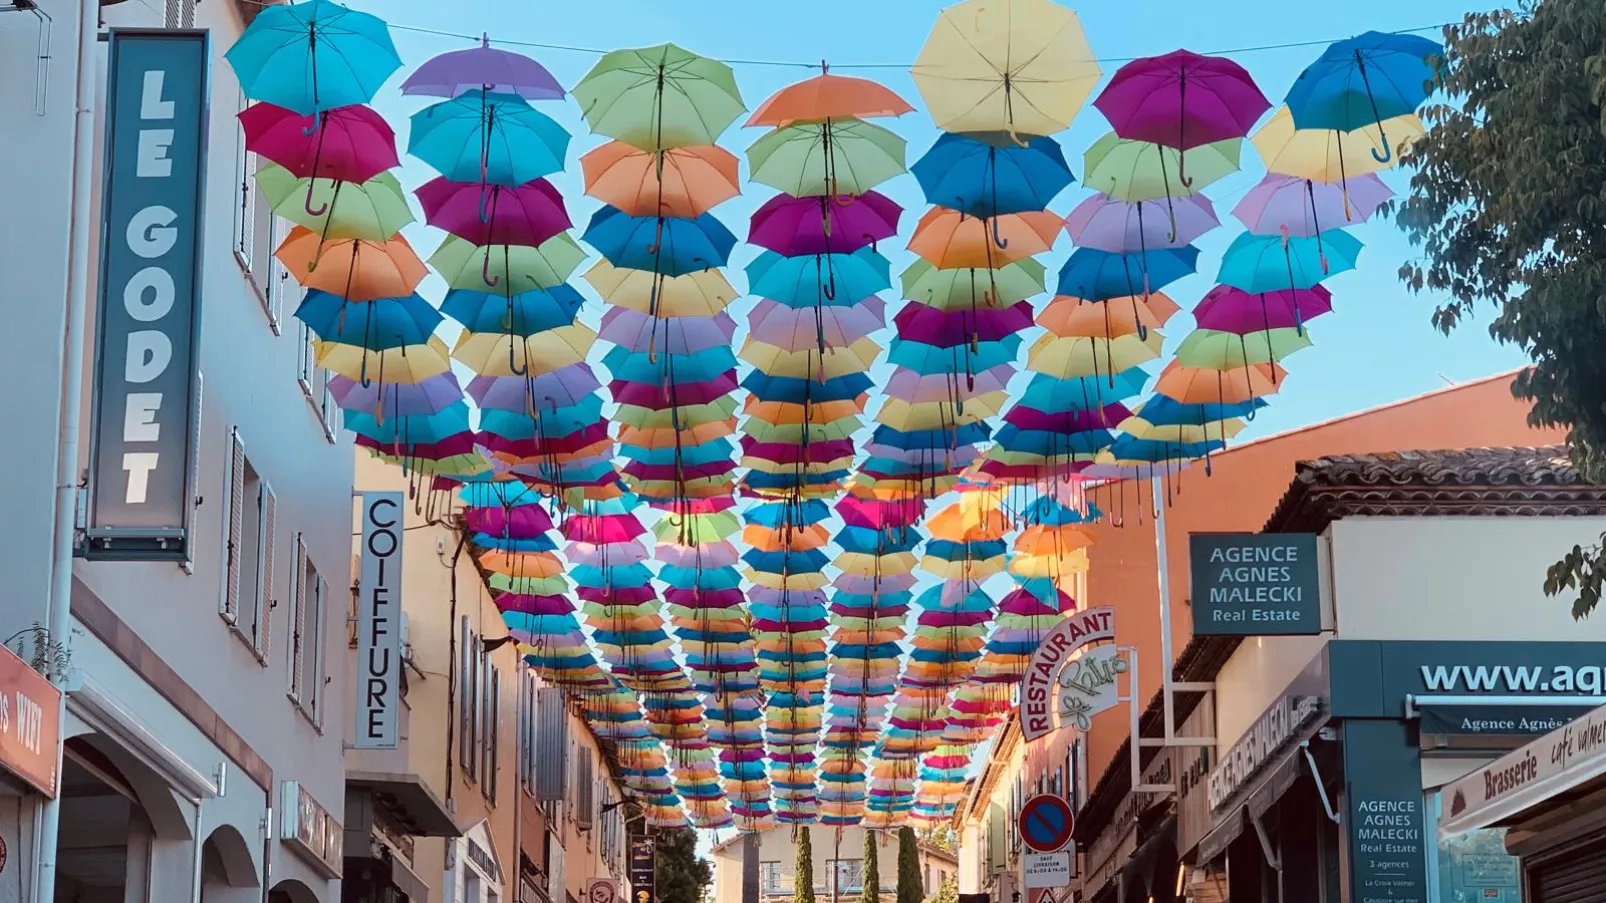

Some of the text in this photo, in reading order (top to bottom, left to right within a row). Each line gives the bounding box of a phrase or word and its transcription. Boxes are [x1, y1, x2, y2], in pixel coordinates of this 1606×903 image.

[122, 70, 179, 504] LE GODET
[1209, 546, 1299, 563] AGENCE
[1218, 566, 1291, 583] AGNES
[1209, 586, 1302, 603] MALECKI
[367, 499, 398, 738] COIFFURE
[1213, 609, 1301, 622] Real Estate
[1027, 611, 1112, 733] RESTAURANT
[1420, 665, 1606, 696] www.ag
[16, 690, 42, 755] WIFI
[1461, 717, 1515, 731] Agence
[1484, 750, 1538, 800] Brasserie
[1551, 726, 1573, 770] café
[1358, 801, 1416, 812] AGENCE
[1364, 815, 1411, 826] AGNES
[1358, 829, 1418, 840] MALECKI
[1360, 844, 1418, 853] Real Estate
[1377, 861, 1410, 870] agences
